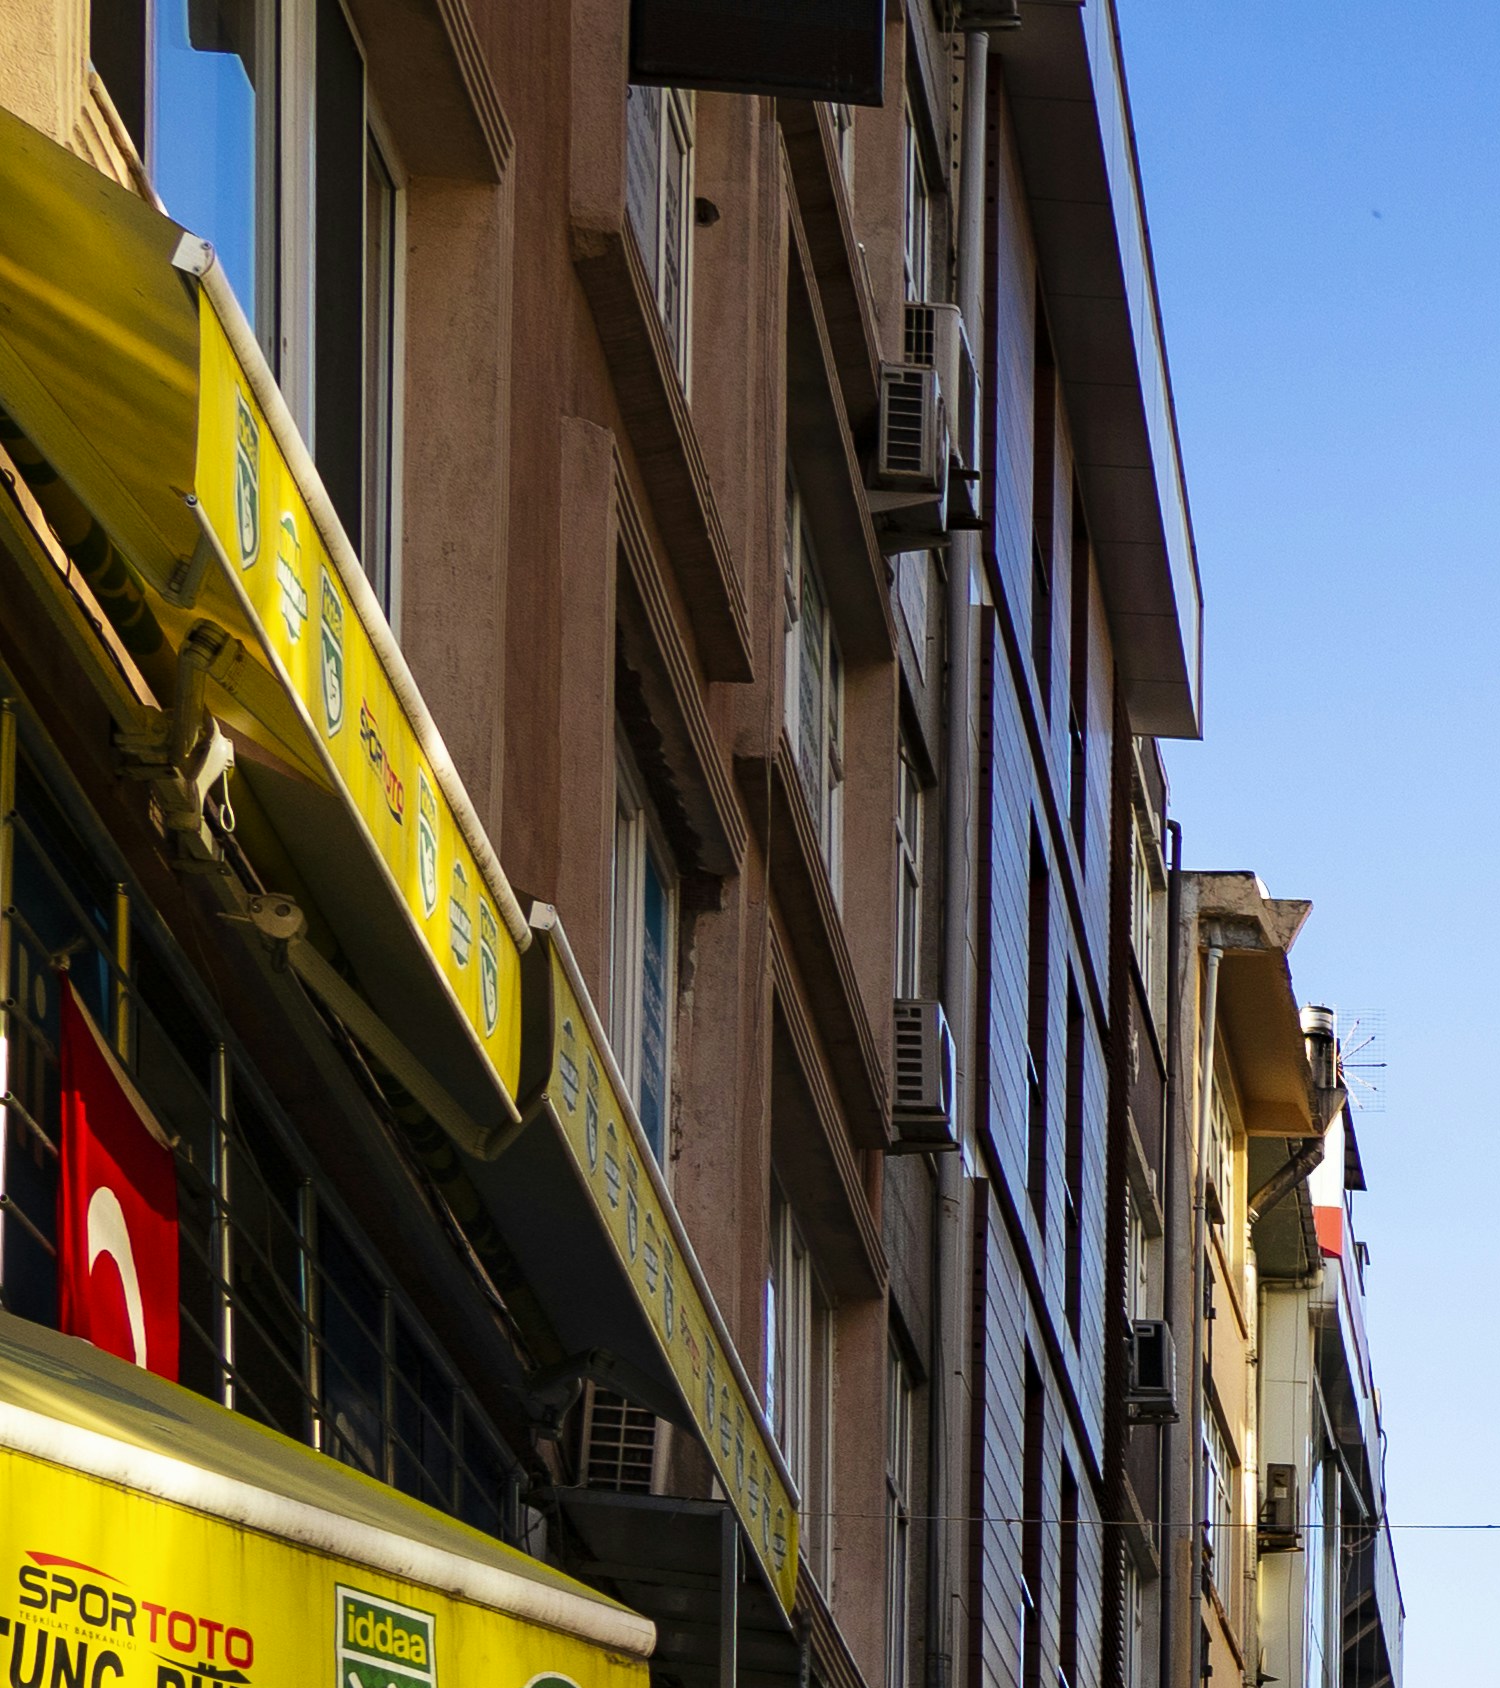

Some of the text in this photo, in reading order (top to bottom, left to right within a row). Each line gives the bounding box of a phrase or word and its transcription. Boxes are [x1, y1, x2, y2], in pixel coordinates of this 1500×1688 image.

[19, 1611, 137, 1651] TEŞKİLAT BAŞKANLIĞI
[347, 1604, 427, 1666] iddaa
